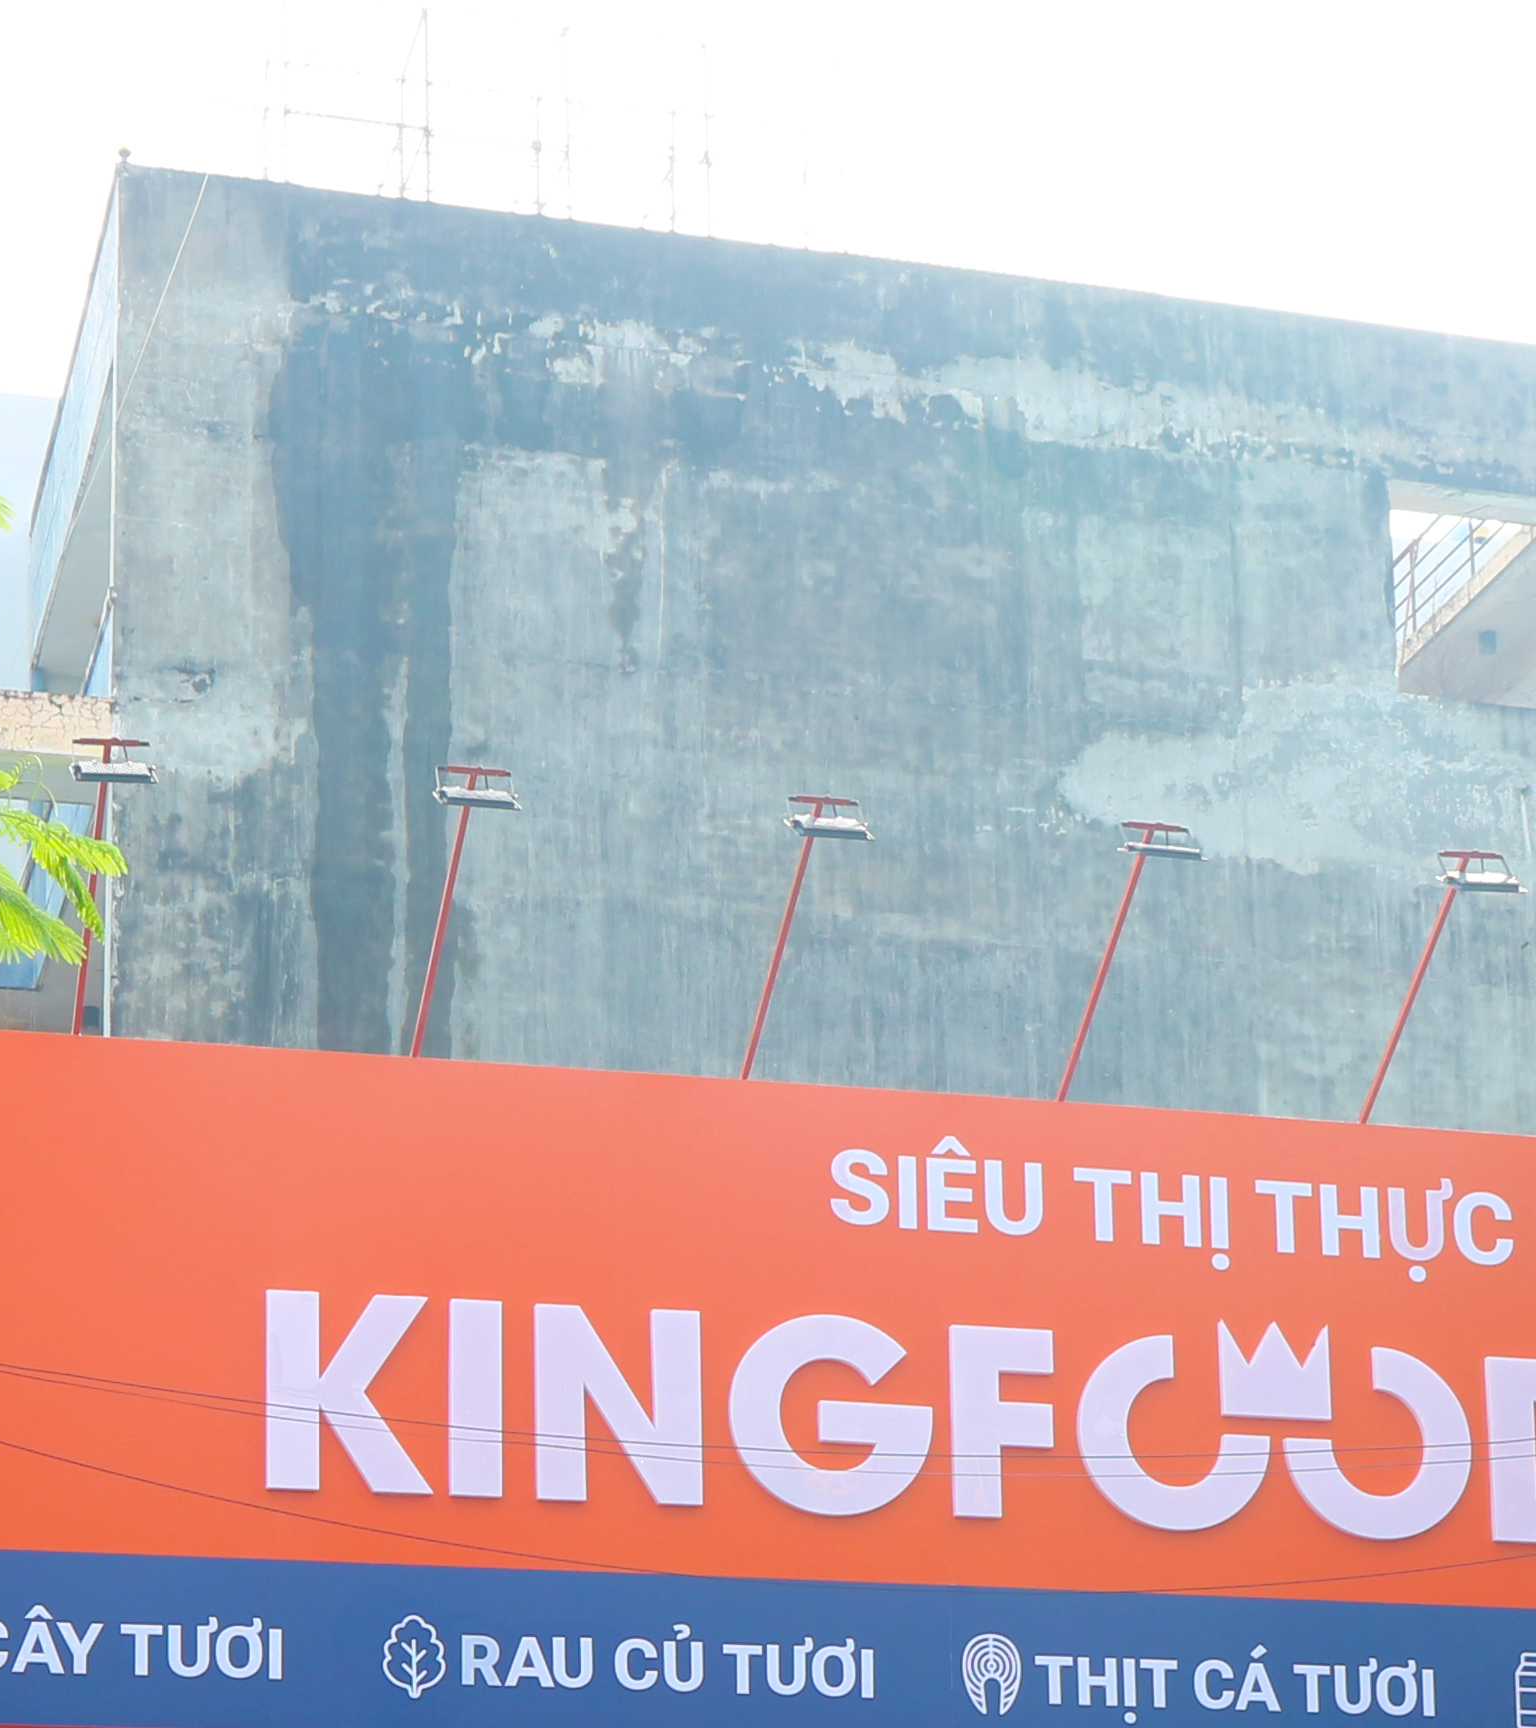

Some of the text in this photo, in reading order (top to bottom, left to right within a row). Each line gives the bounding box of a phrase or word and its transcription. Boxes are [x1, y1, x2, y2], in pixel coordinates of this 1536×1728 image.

[830, 1136, 1045, 1236] SIÊU
[1073, 1166, 1232, 1271] THỊ
[1255, 1177, 1514, 1283] THỰC
[120, 1618, 284, 1682] TƯƠI
[461, 1624, 875, 1699] RAU CỦ TƯƠI
[1034, 1645, 1437, 1725] THỊT CÁ TƯƠI
